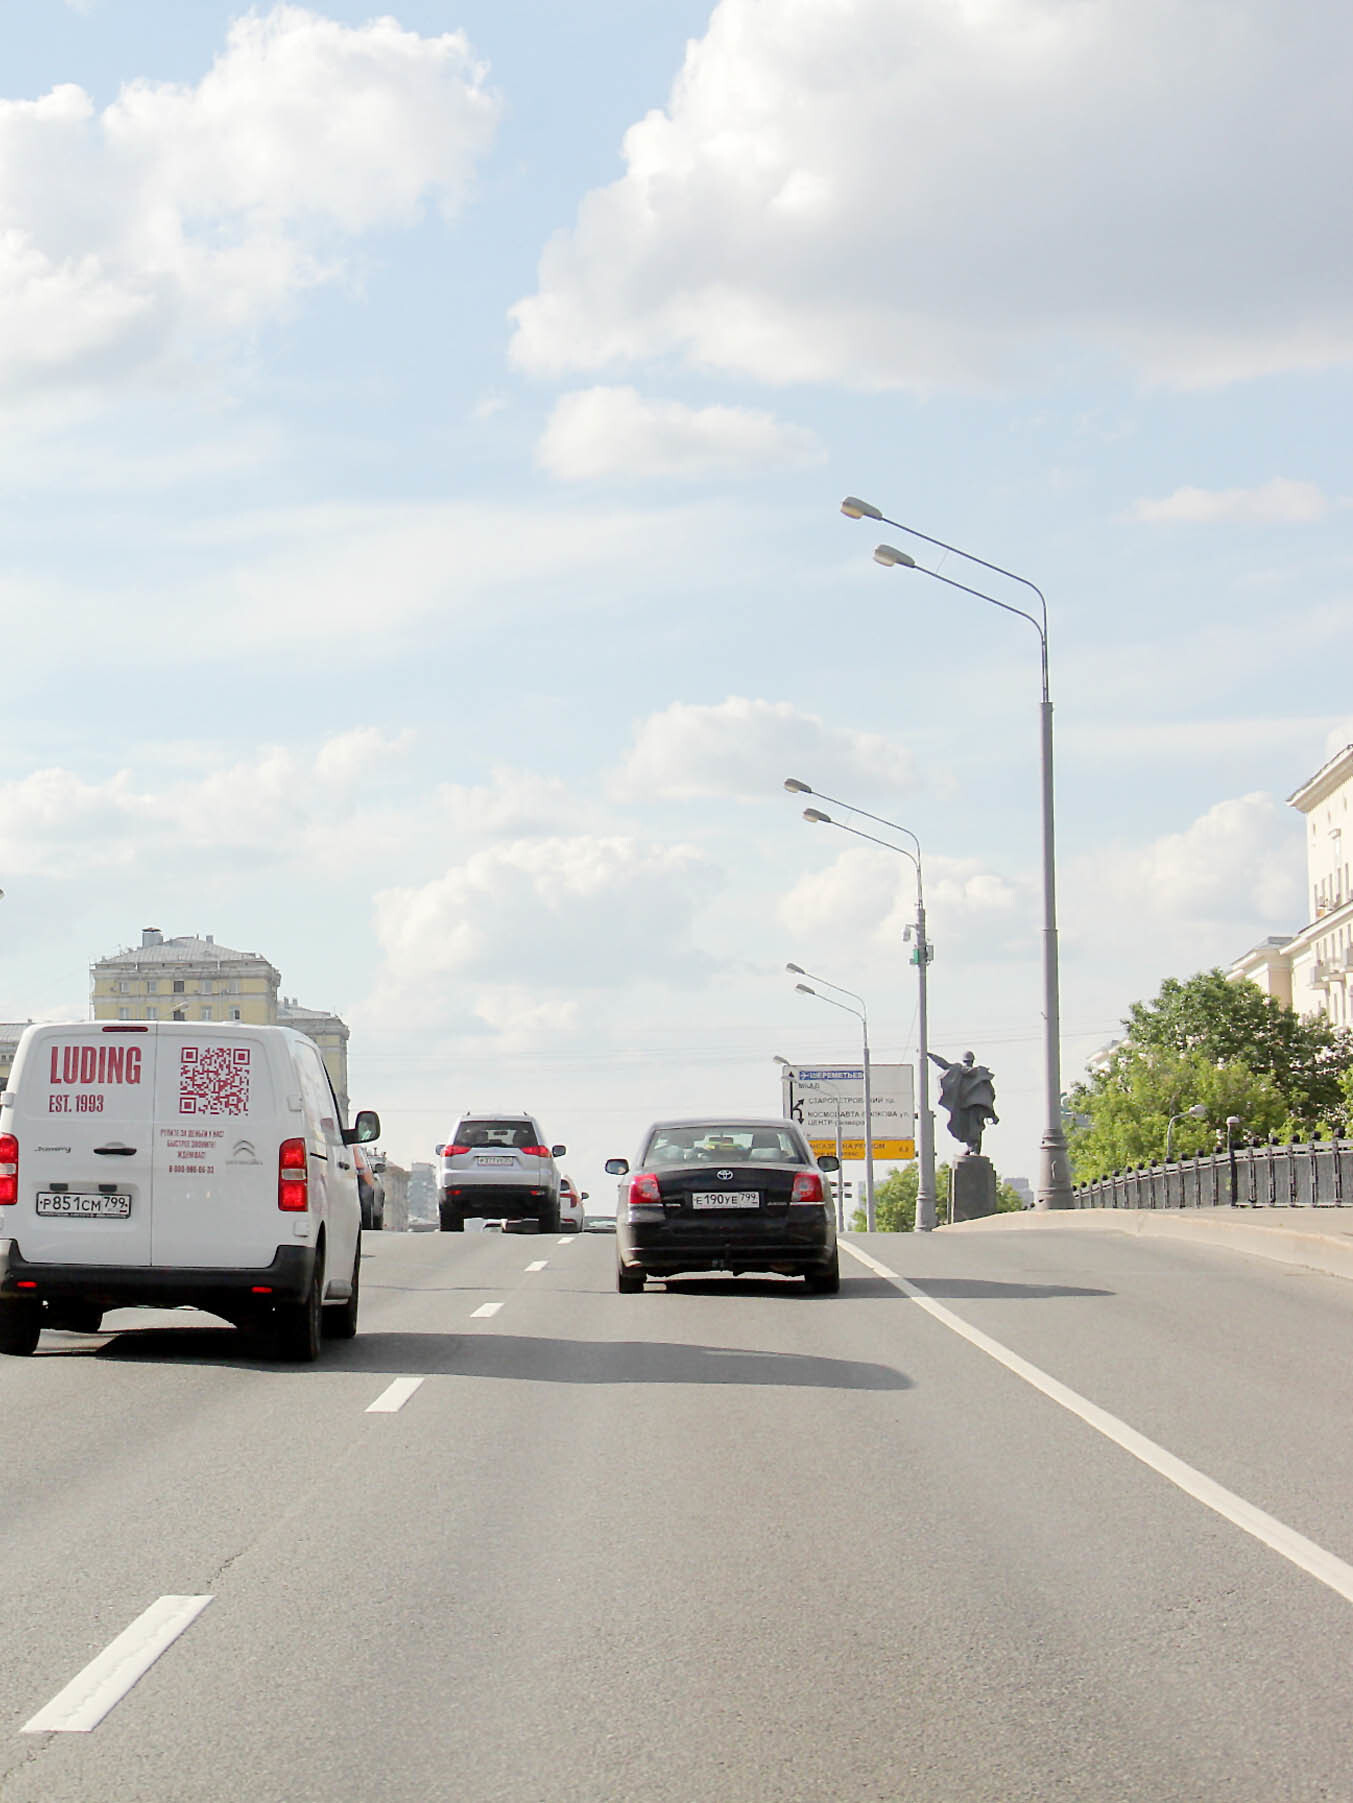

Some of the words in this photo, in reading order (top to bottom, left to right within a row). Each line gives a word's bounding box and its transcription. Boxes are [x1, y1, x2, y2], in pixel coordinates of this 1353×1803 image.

[50, 1046, 142, 1084] LUDING
[809, 1071, 865, 1079] ШЕРЕМЕТЬЕВ
[49, 1094, 72, 1112] EST.
[76, 1094, 104, 1112] 1993
[42, 1196, 102, 1212] Р851СМ
[103, 1196, 126, 1208] 799
[696, 1194, 738, 1205] Е190УЕ
[739, 1192, 756, 1201] 799
